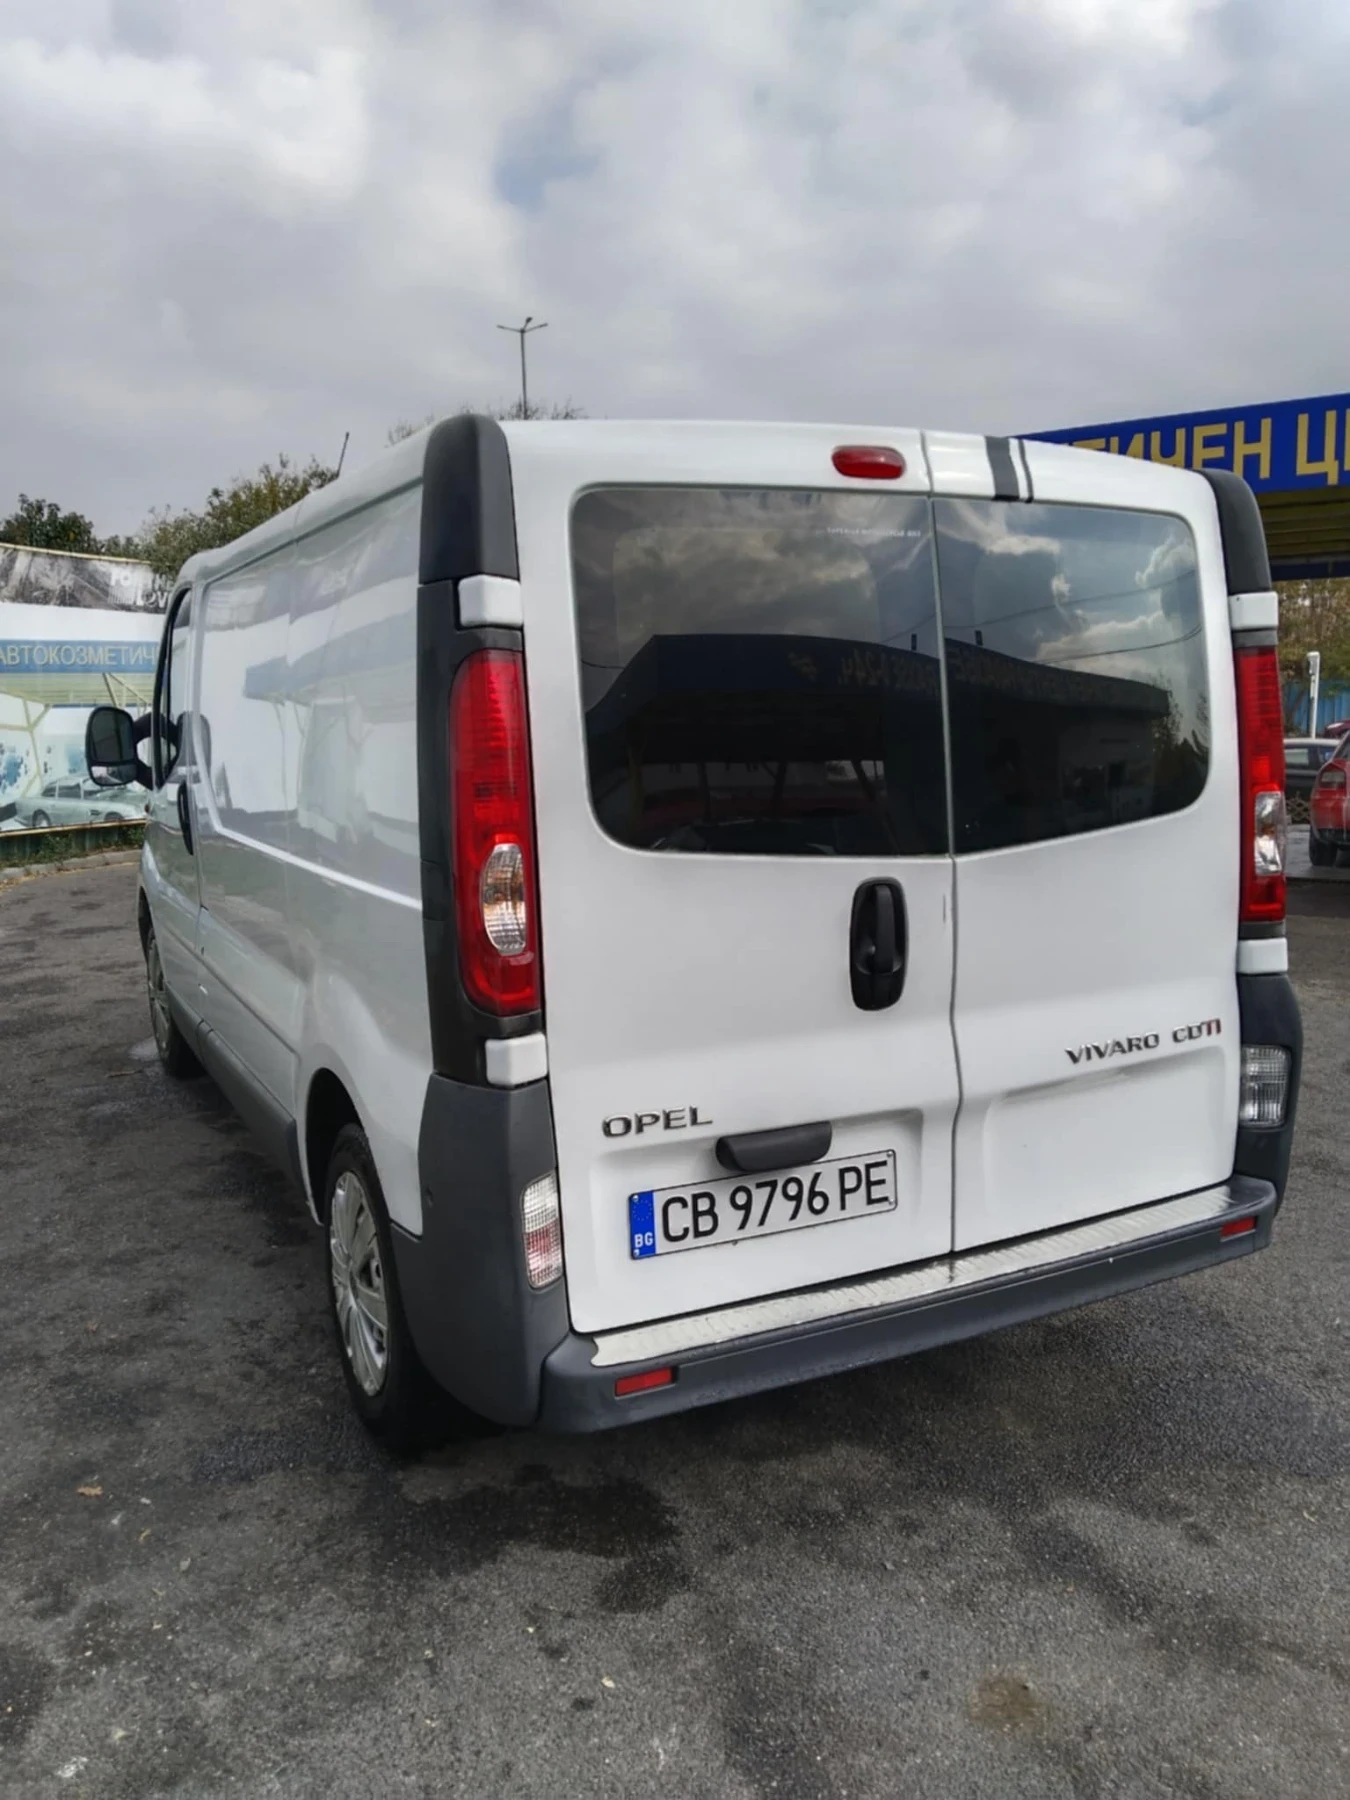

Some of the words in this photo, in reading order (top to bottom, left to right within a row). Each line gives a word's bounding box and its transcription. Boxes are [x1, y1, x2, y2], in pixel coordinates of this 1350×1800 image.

[1296, 407, 1350, 486] Ц
[0, 645, 159, 665] АВТОКОЗМЕТИЧ
[1064, 1031, 1160, 1065] VIVARO
[1171, 1017, 1222, 1044] CDTI
[601, 1105, 714, 1138] OPEL
[661, 1191, 719, 1243] CB
[729, 1171, 830, 1231] 9796
[838, 1160, 889, 1211] PE
[634, 1231, 654, 1249] BG
